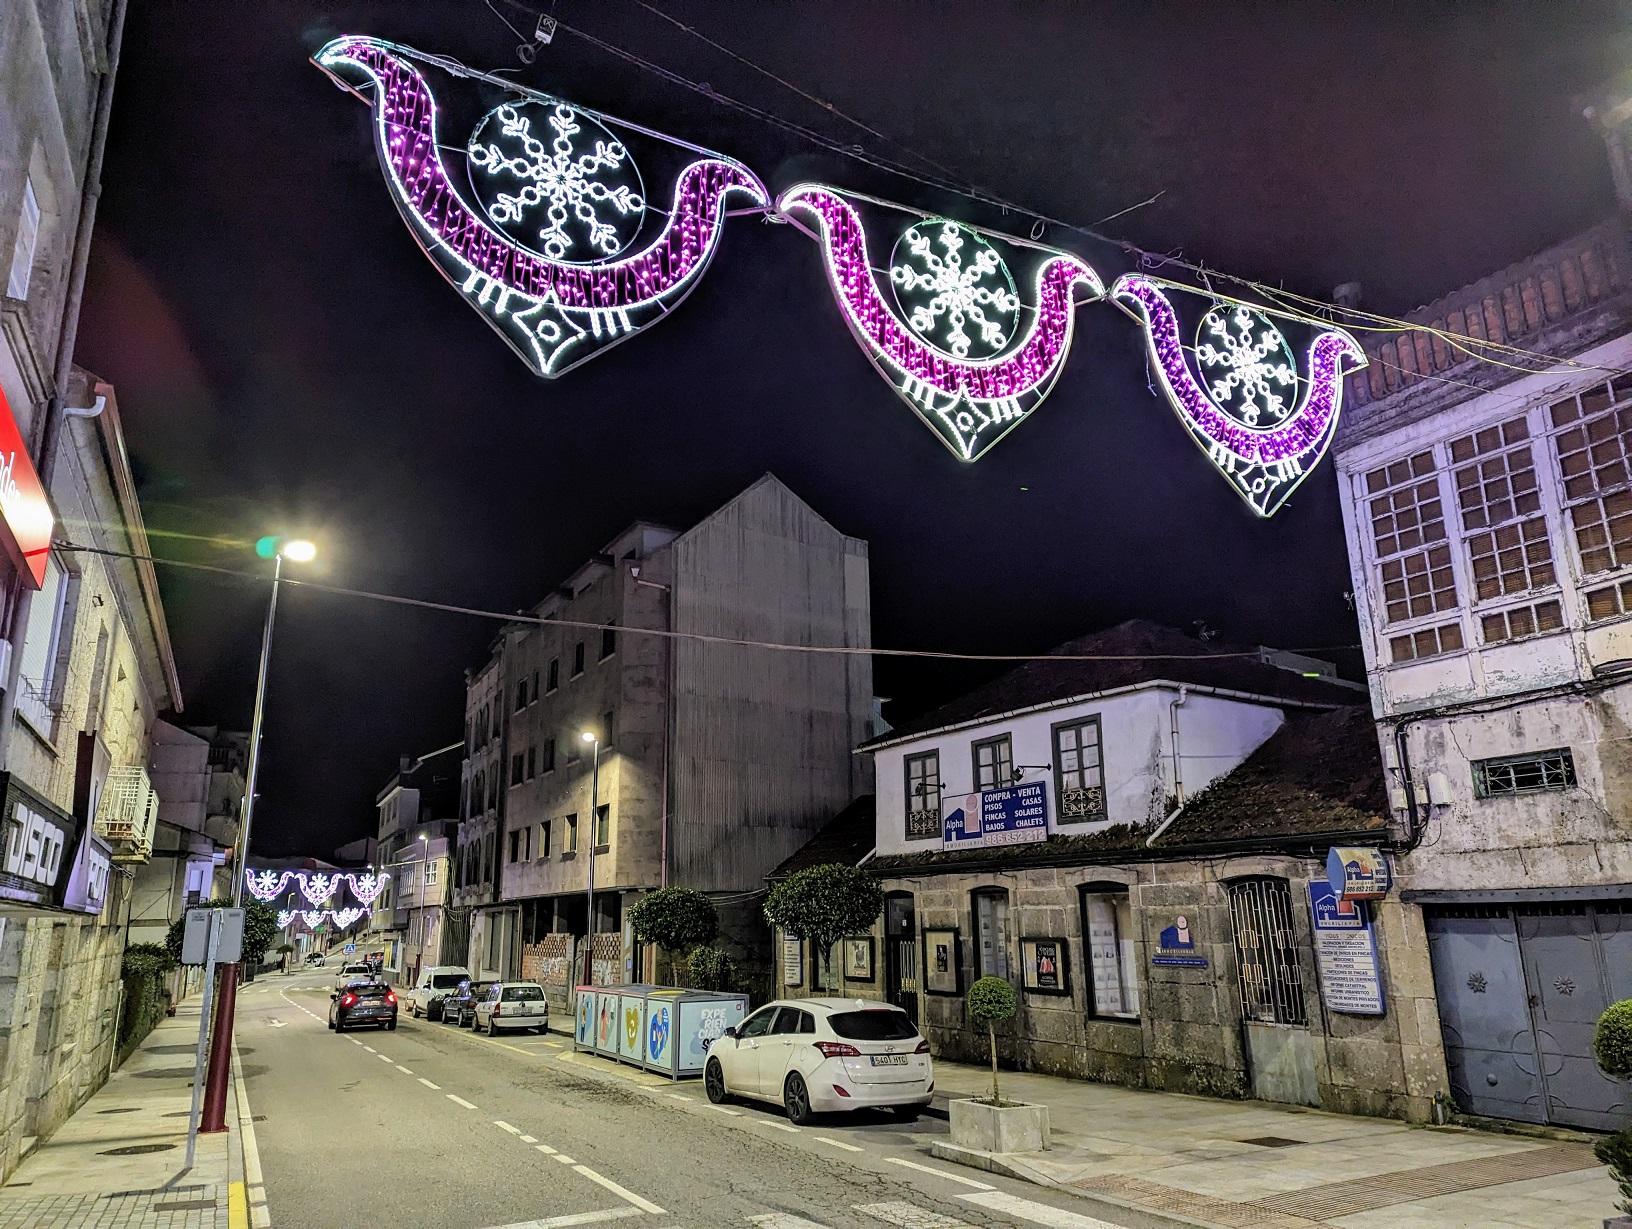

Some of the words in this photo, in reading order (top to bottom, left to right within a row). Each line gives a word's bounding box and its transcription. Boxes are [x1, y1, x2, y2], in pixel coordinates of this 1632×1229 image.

[984, 792, 1011, 803] COMPRA
[1017, 786, 1041, 798] VENTA
[1021, 797, 1042, 806] CASAS
[984, 802, 1003, 811] PISOS
[984, 812, 1007, 821] FINCAS
[1014, 807, 1043, 817] SOLARES
[946, 819, 964, 831] Alpha
[985, 822, 1005, 831] BAJOS
[1015, 817, 1044, 828] CHALETS
[1347, 866, 1360, 874] Alpha
[1319, 904, 1336, 912] Alpha
[701, 1008, 727, 1020] EXPE
[704, 1018, 727, 1030] RIEN
